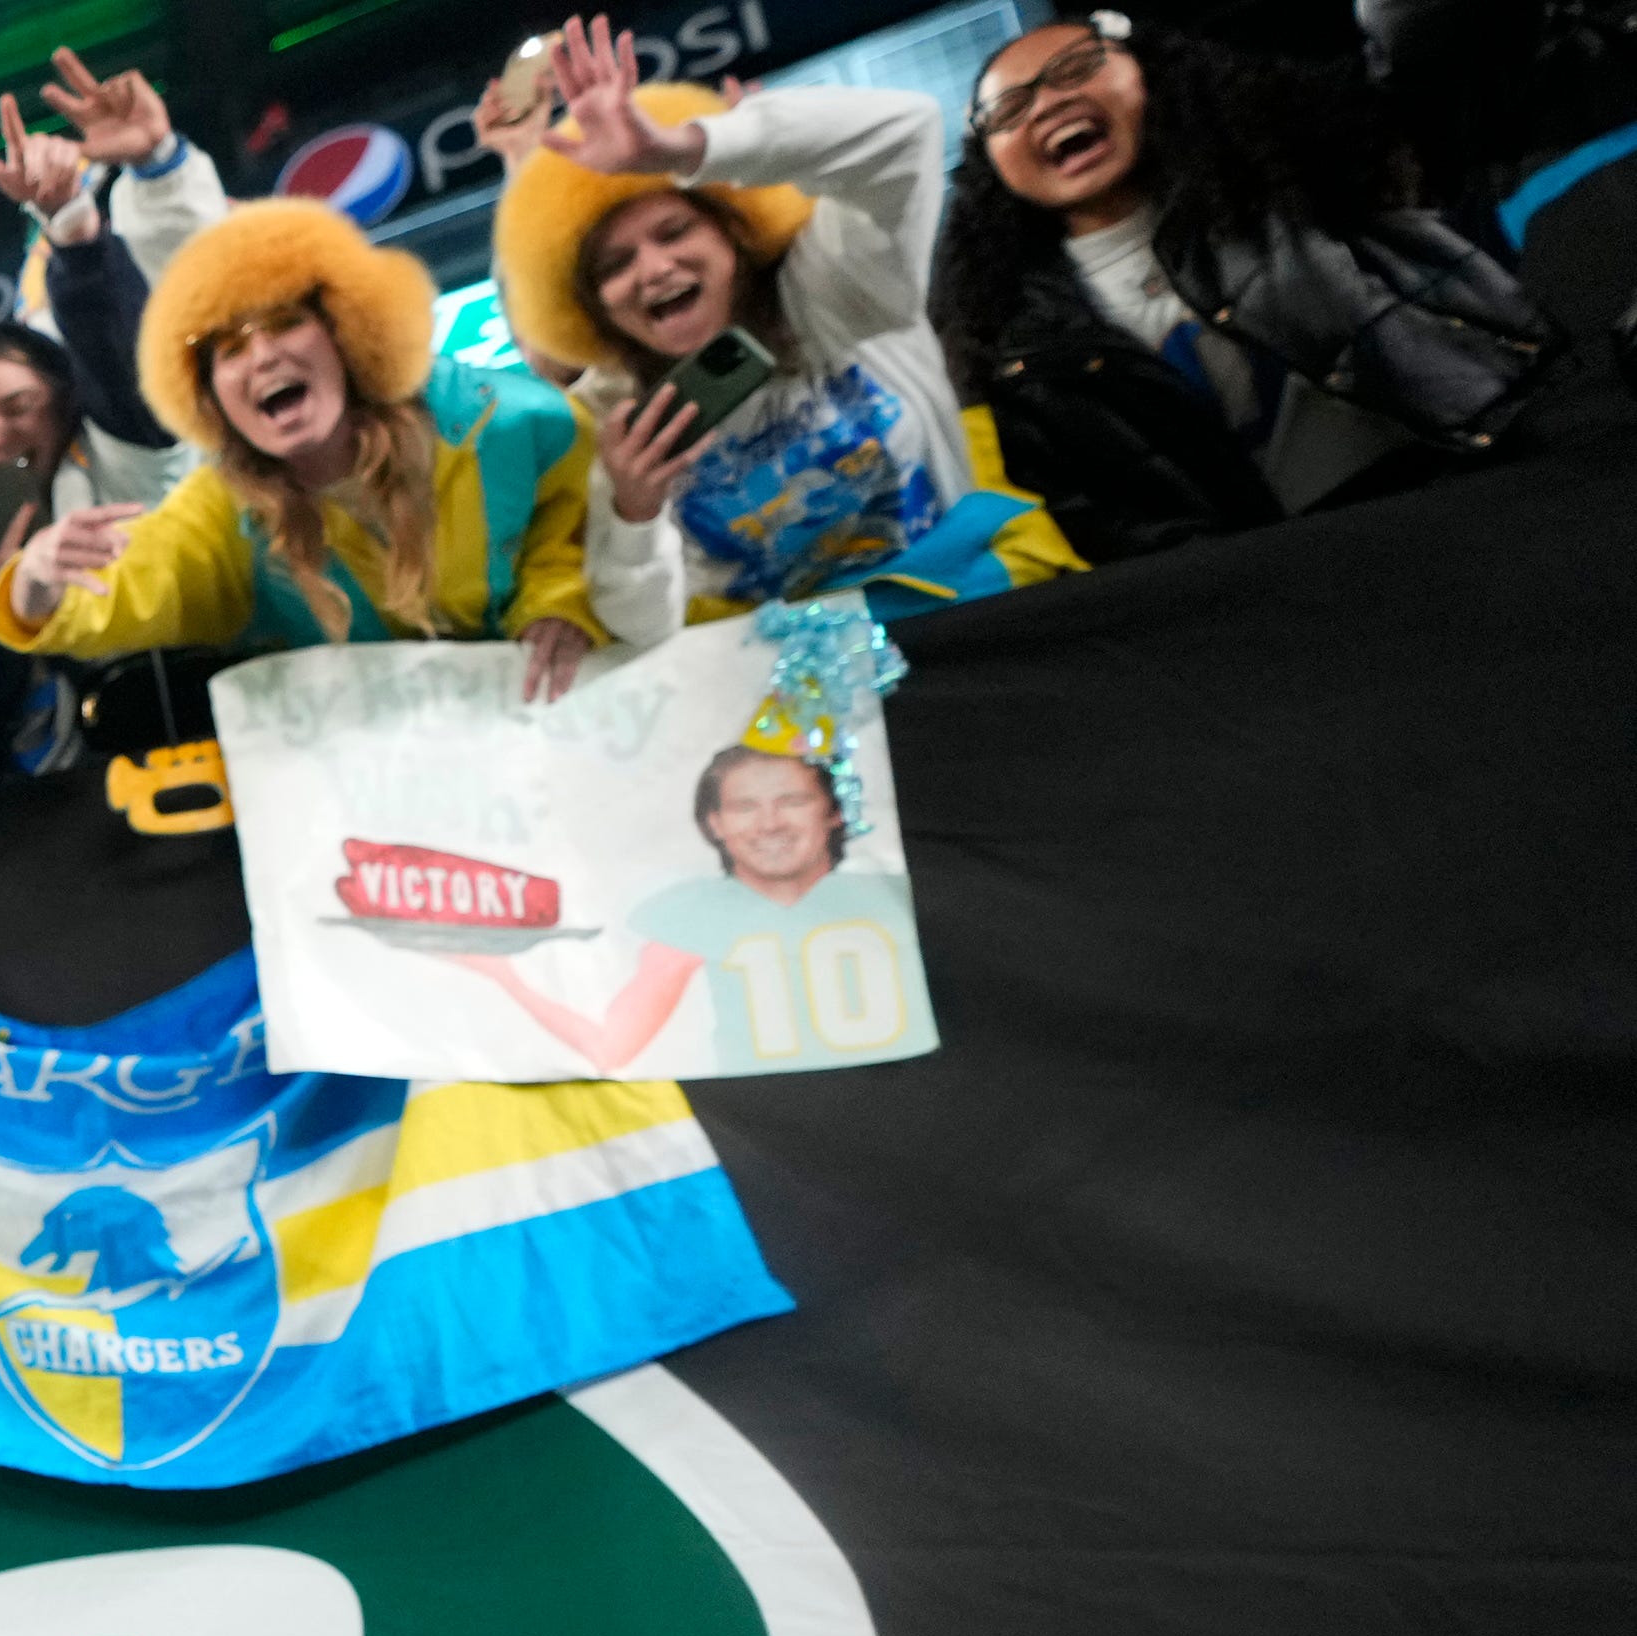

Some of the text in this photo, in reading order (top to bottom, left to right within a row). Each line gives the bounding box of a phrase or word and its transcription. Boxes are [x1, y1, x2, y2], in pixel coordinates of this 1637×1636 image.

[357, 859, 532, 919] VICTORY
[723, 917, 907, 1062] 10
[8, 1319, 244, 1376] CHARGERS
